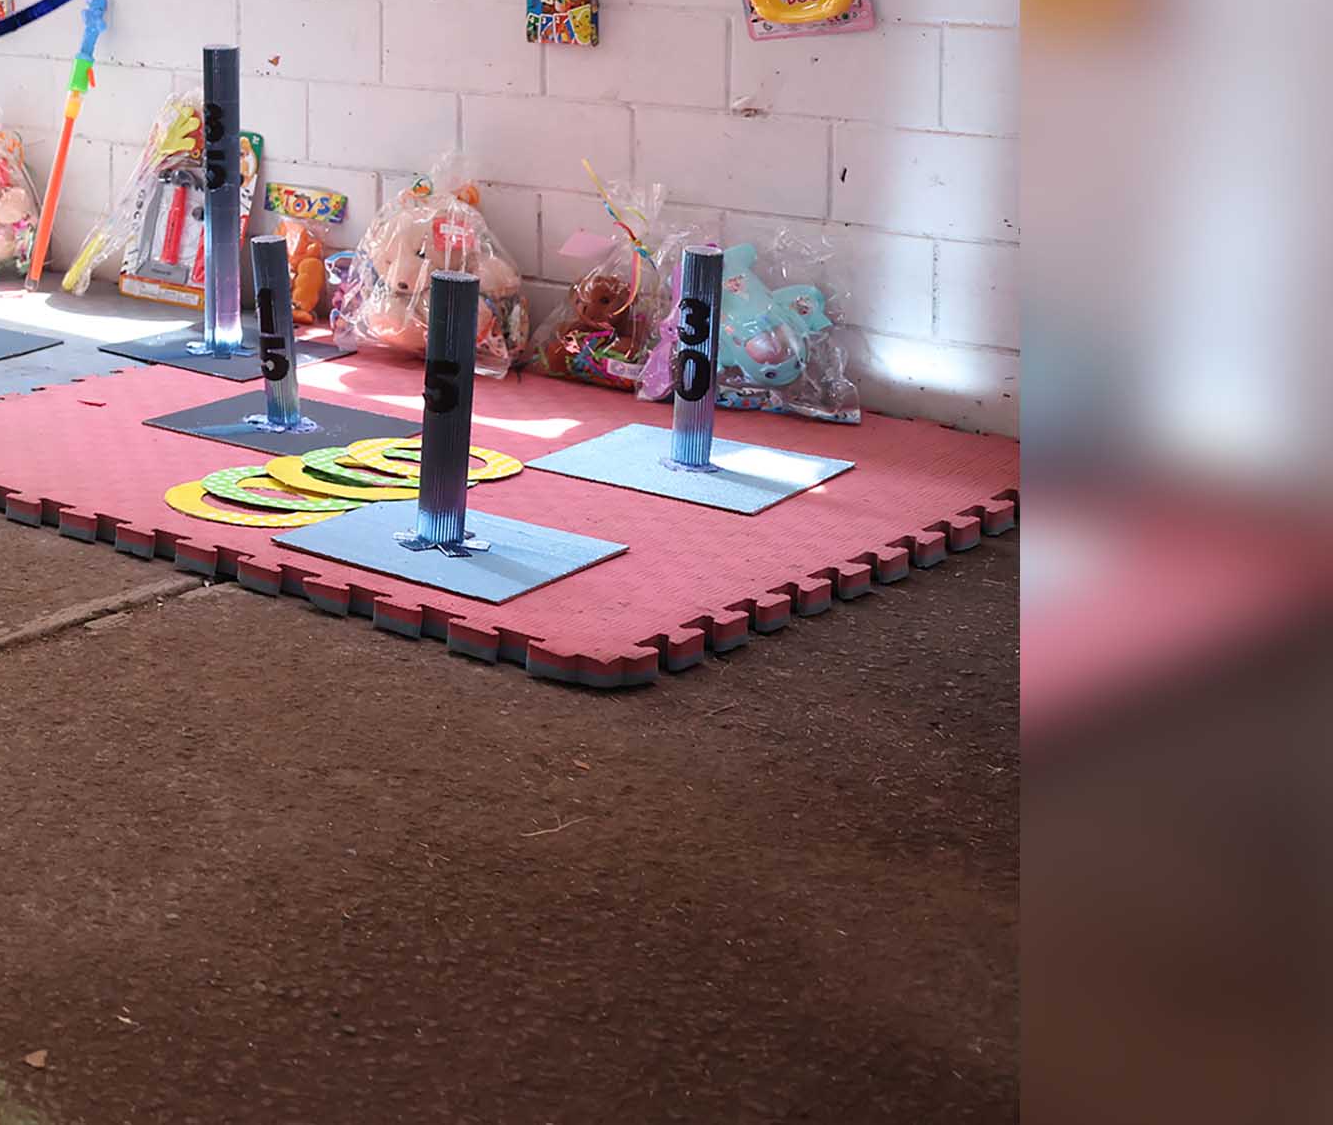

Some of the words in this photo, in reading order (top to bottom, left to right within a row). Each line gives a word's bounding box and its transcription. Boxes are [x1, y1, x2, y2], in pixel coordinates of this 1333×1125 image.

[258, 287, 290, 381] 15
[676, 298, 710, 401] 30
[424, 361, 461, 413] 5
